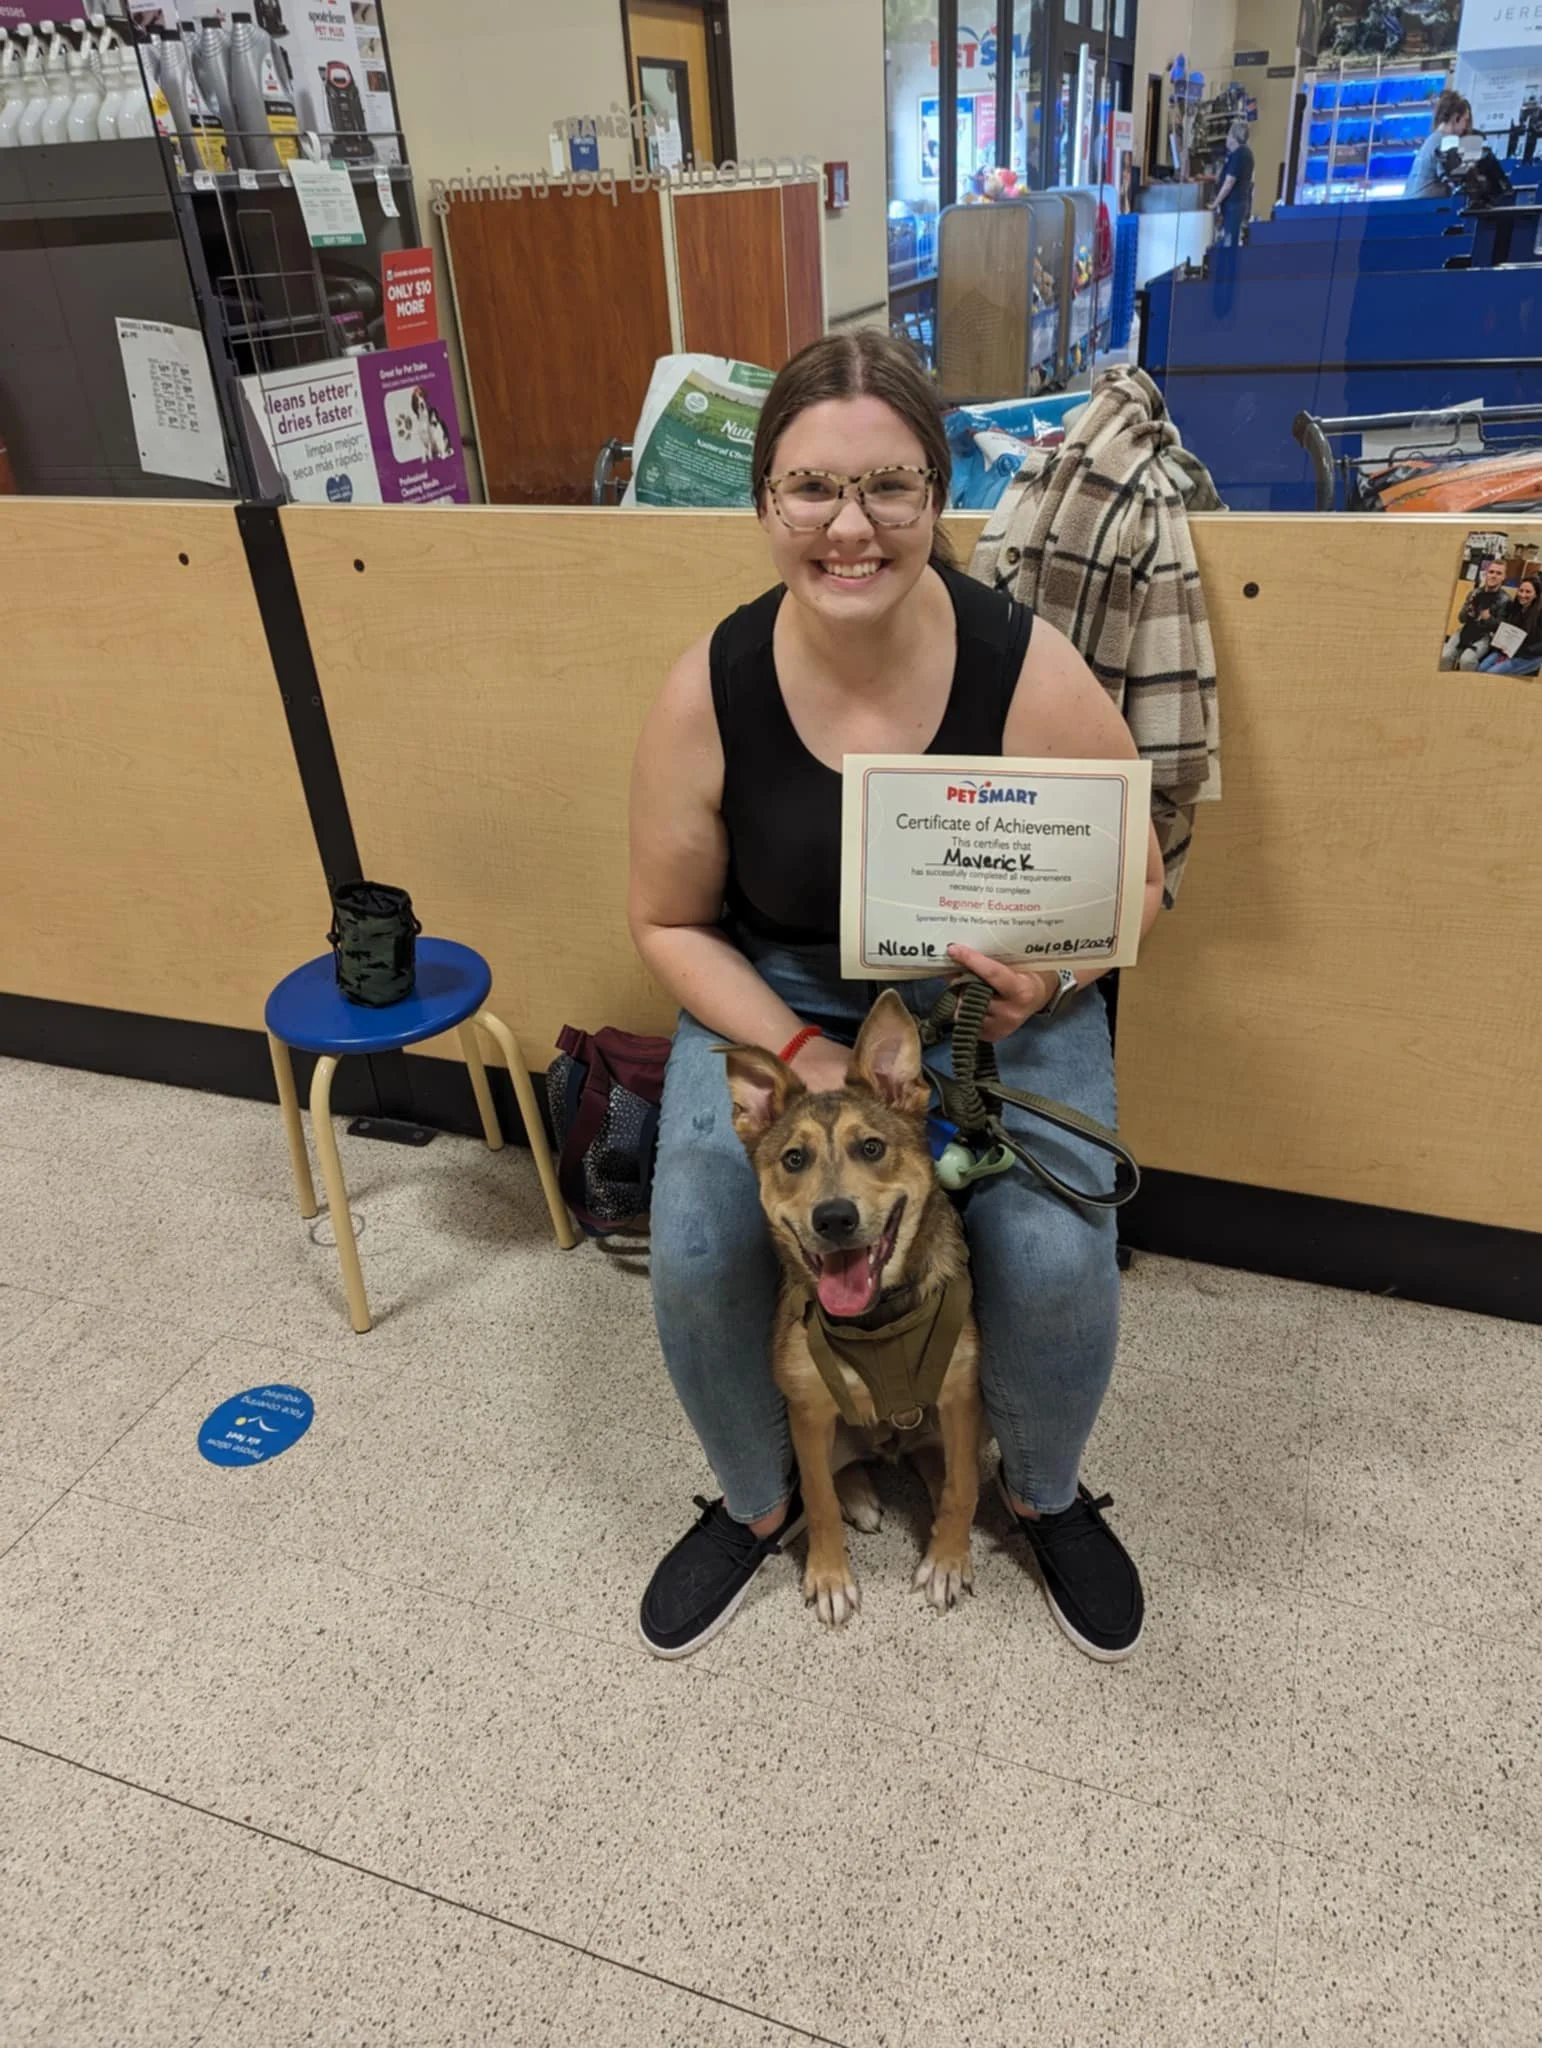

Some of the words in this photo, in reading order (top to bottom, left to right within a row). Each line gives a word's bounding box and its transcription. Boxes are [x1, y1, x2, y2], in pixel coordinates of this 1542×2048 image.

[388, 282, 413, 301] ONLY
[415, 280, 432, 295] $10
[396, 299, 425, 317] MORE
[379, 367, 395, 380] Great
[404, 364, 412, 374] Pet
[412, 362, 428, 373] Stains
[278, 412, 312, 435] dries
[316, 404, 353, 425] faster
[305, 442, 334, 458] limpia
[293, 465, 314, 480] seca
[315, 458, 334, 474] más
[947, 783, 1038, 806] PETSMART
[896, 813, 971, 832] Certificate
[975, 815, 991, 832] of
[993, 817, 1091, 836] Achievement
[952, 836, 971, 848] This
[972, 838, 1010, 850] certifies
[1012, 841, 1032, 851] that
[911, 867, 924, 877] has
[925, 869, 967, 881] successfully
[968, 871, 1006, 883] completed
[1009, 872, 1018, 882] all
[1020, 873, 1071, 884] requirements
[949, 883, 984, 894] necessary
[995, 886, 1031, 896] complete
[938, 896, 985, 913] Beginner
[987, 899, 1040, 912] Education
[281, 1406, 305, 1419] Face
[225, 1431, 246, 1443] feet
[247, 1436, 262, 1445] six
